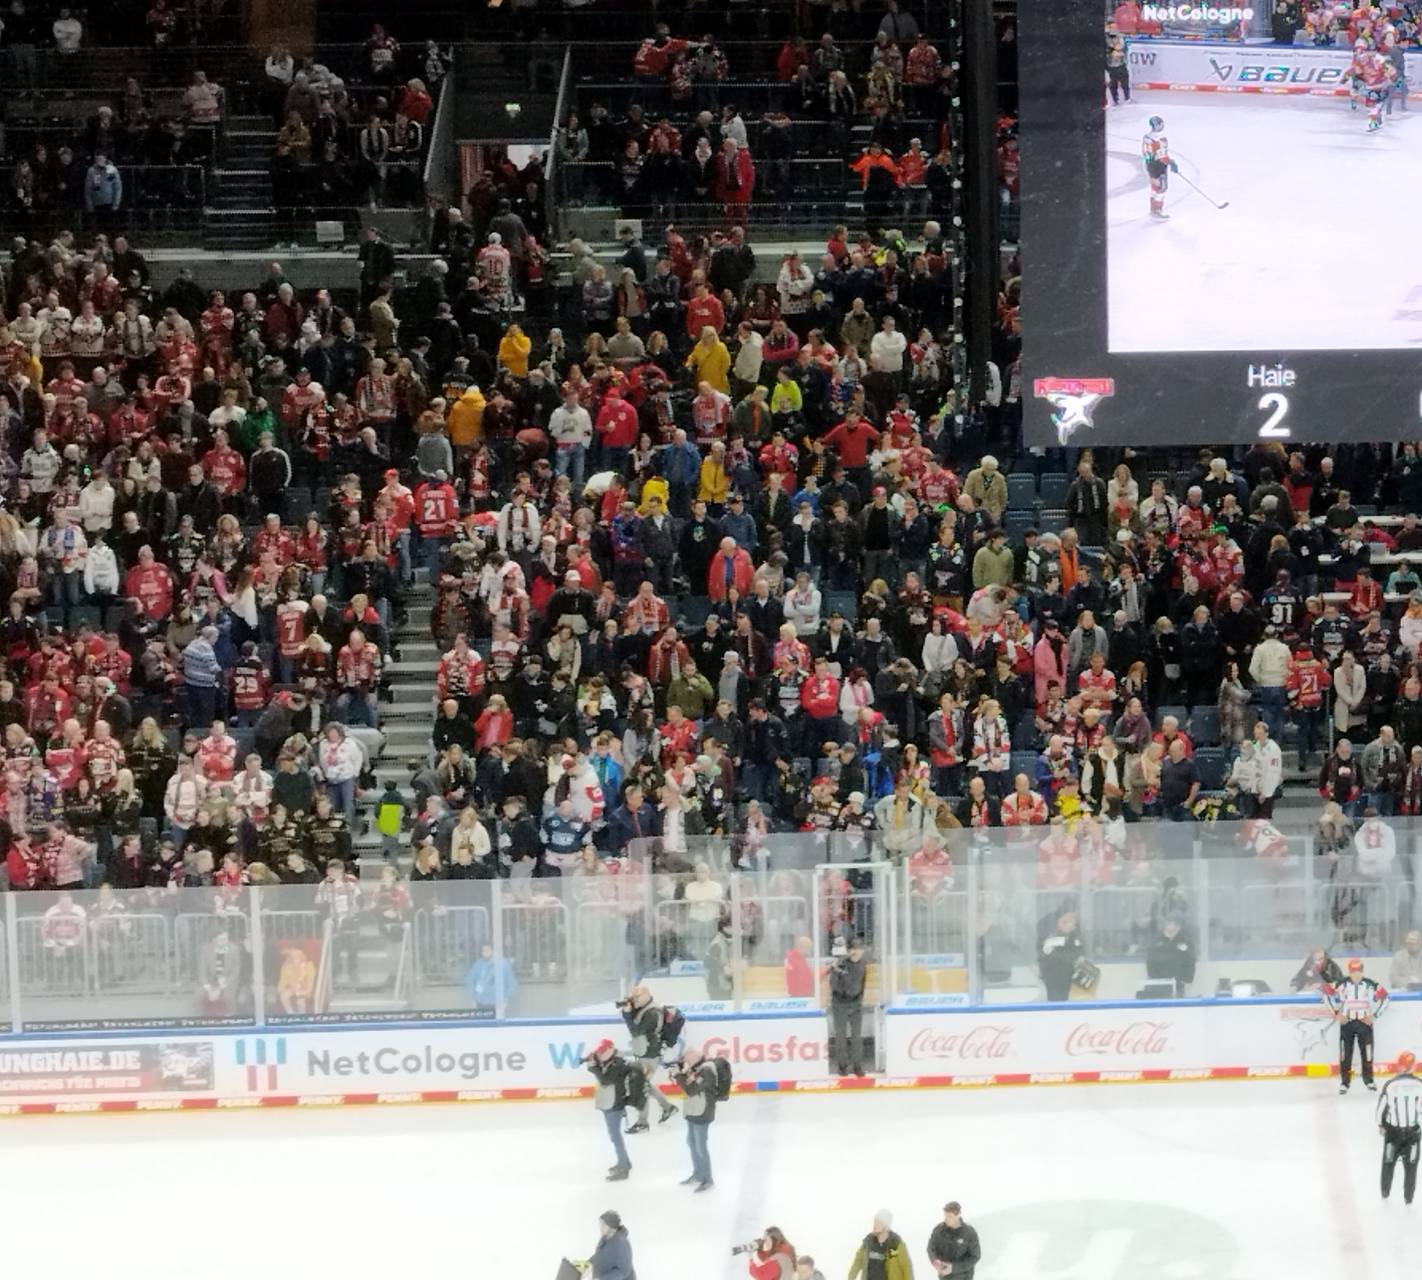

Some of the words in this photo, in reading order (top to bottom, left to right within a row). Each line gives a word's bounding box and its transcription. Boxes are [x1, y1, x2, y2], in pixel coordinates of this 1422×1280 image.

[1143, 4, 1255, 24] NetCologne
[1247, 364, 1296, 388] Haie
[1257, 393, 1291, 437] 2
[424, 499, 446, 520] 21
[1271, 603, 1293, 623] 91
[908, 1025, 1017, 1060] Coca-Cola
[1065, 1021, 1174, 1056] Coca-Cola
[307, 1045, 527, 1080] NetCologne
